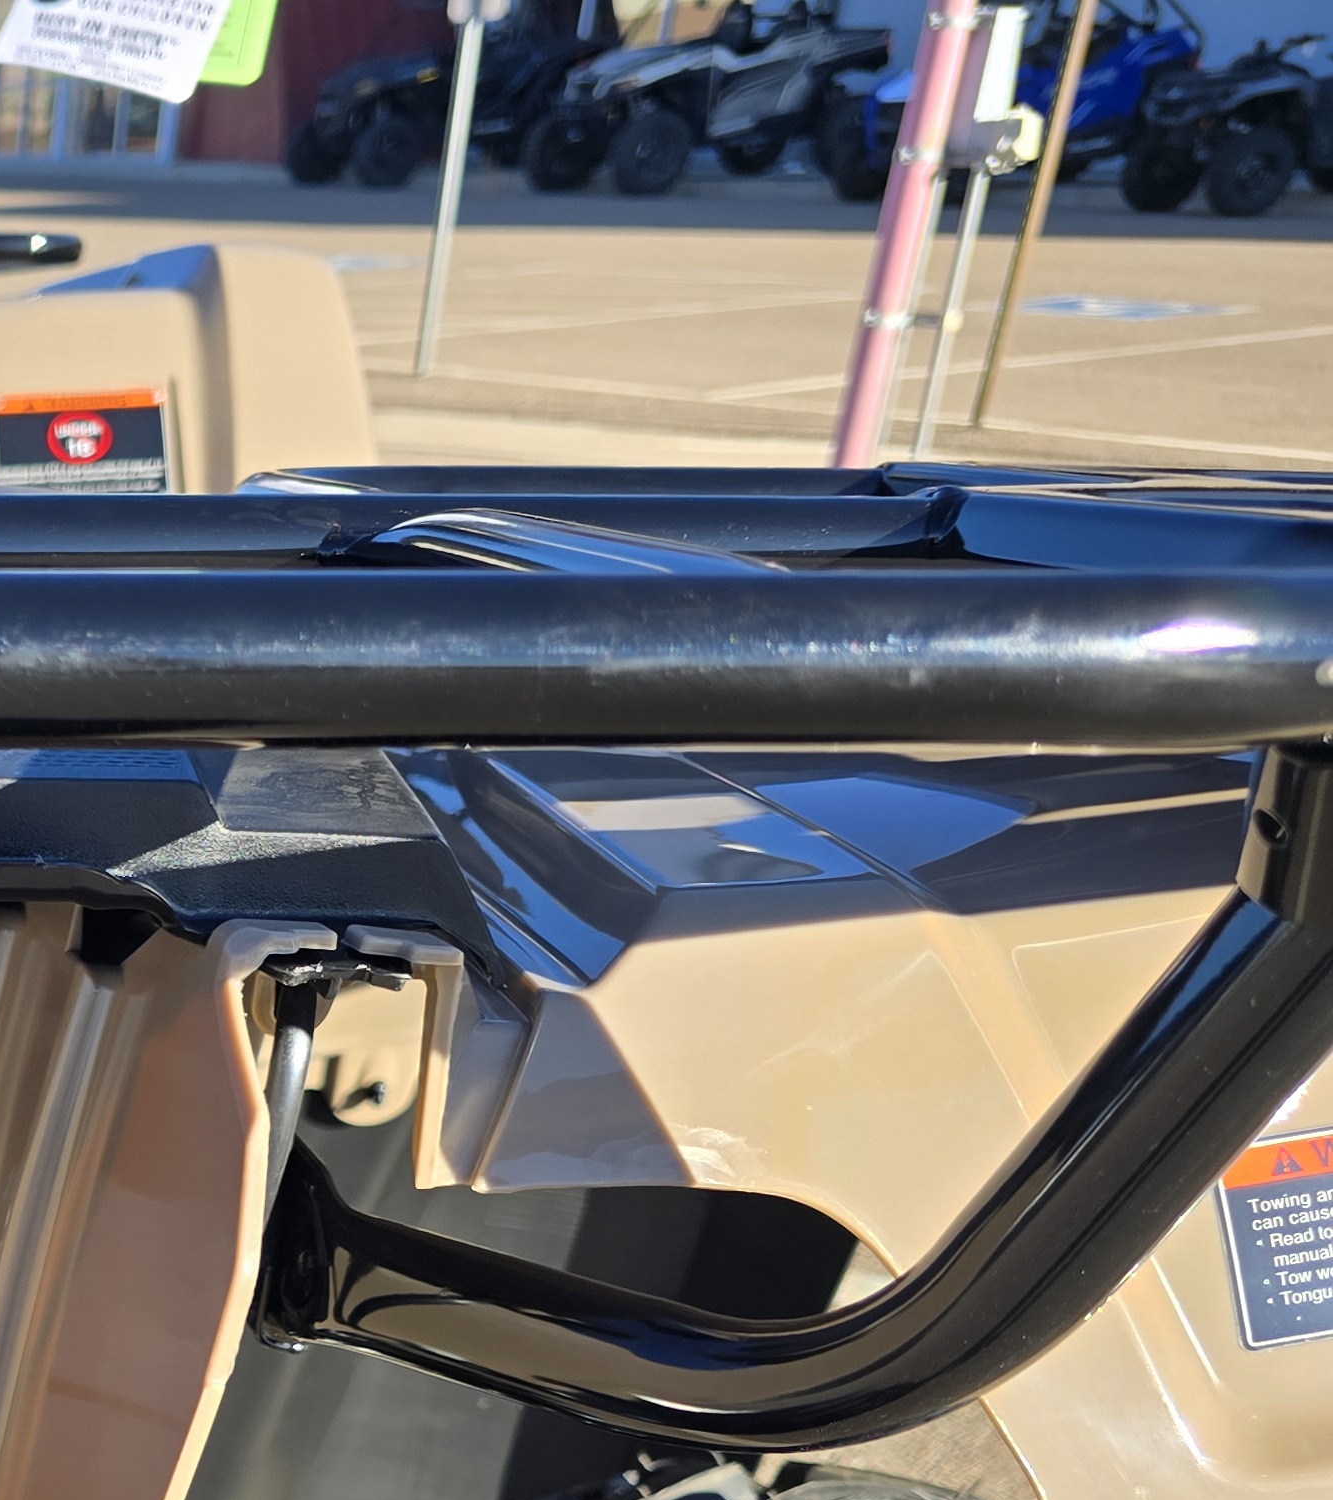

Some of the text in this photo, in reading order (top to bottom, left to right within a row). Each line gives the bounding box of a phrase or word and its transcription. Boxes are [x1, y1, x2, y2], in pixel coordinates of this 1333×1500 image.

[1246, 1193, 1312, 1214] Towing
[1251, 1215, 1284, 1231] can
[1269, 1227, 1314, 1248] Read
[1273, 1243, 1333, 1268] manual
[1275, 1271, 1312, 1286] Tow
